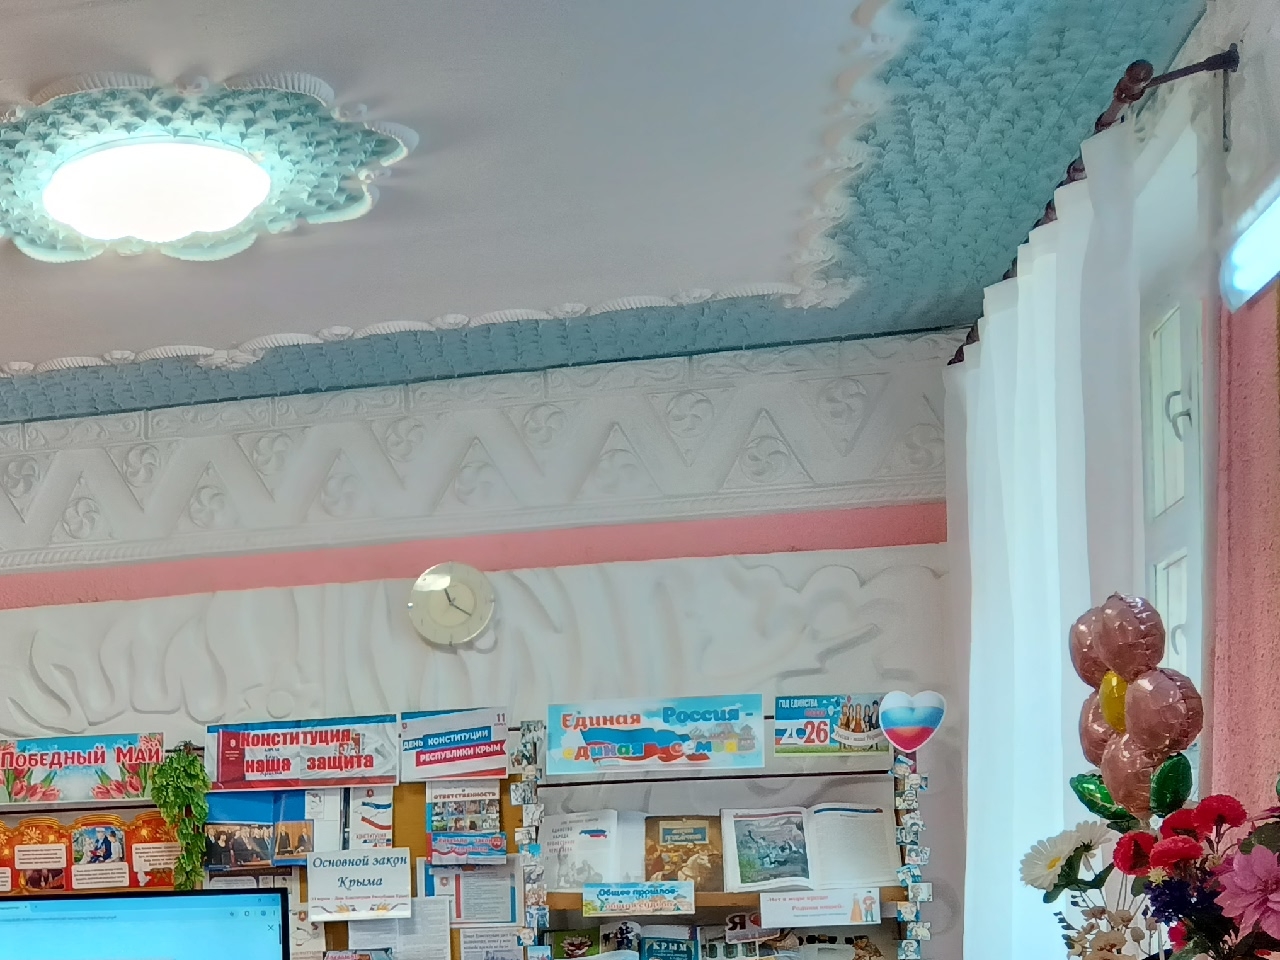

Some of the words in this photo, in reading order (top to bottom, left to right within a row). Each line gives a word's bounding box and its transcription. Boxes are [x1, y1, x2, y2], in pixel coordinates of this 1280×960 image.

[778, 699, 790, 708] ГОД
[496, 713, 506, 722] 11
[562, 712, 641, 730] Единая
[662, 706, 740, 724] Россия
[240, 728, 351, 748] Конституция
[403, 740, 424, 750] ДЕНЬ
[428, 729, 489, 746] КОНСТИТУЦИИ
[420, 747, 474, 763] РЕСПУБЛИКИ
[475, 743, 501, 755] КРЫМ
[563, 742, 645, 761] единая
[245, 757, 292, 774] наша
[306, 754, 375, 772] защита
[313, 855, 370, 868] Основной
[372, 856, 408, 868] закон
[337, 876, 383, 891] Крыма
[598, 888, 631, 897] Общее
[728, 914, 747, 931] Я
[652, 941, 688, 951] КРЫМ
